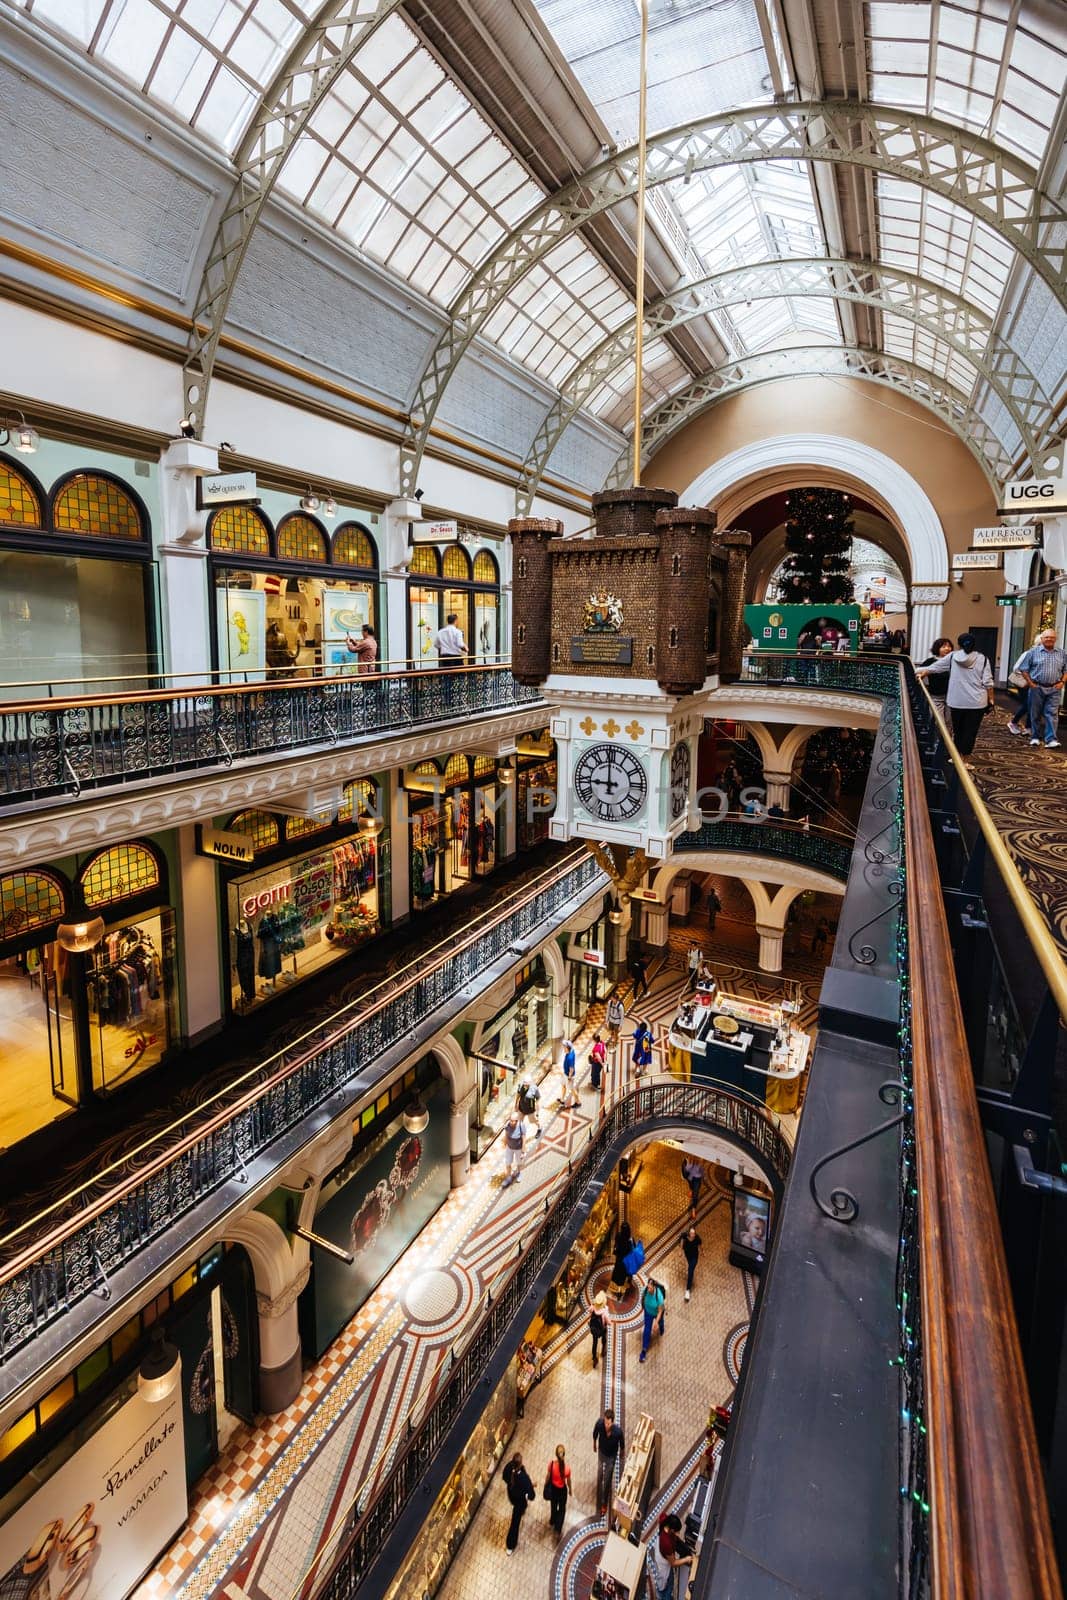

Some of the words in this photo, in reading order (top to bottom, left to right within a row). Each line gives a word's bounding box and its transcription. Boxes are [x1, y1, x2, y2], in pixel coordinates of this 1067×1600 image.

[1011, 484, 1055, 499] UGG
[977, 528, 1032, 538] ALFRESCO
[213, 841, 245, 858] NOLM
[100, 1421, 176, 1500] Pomellato
